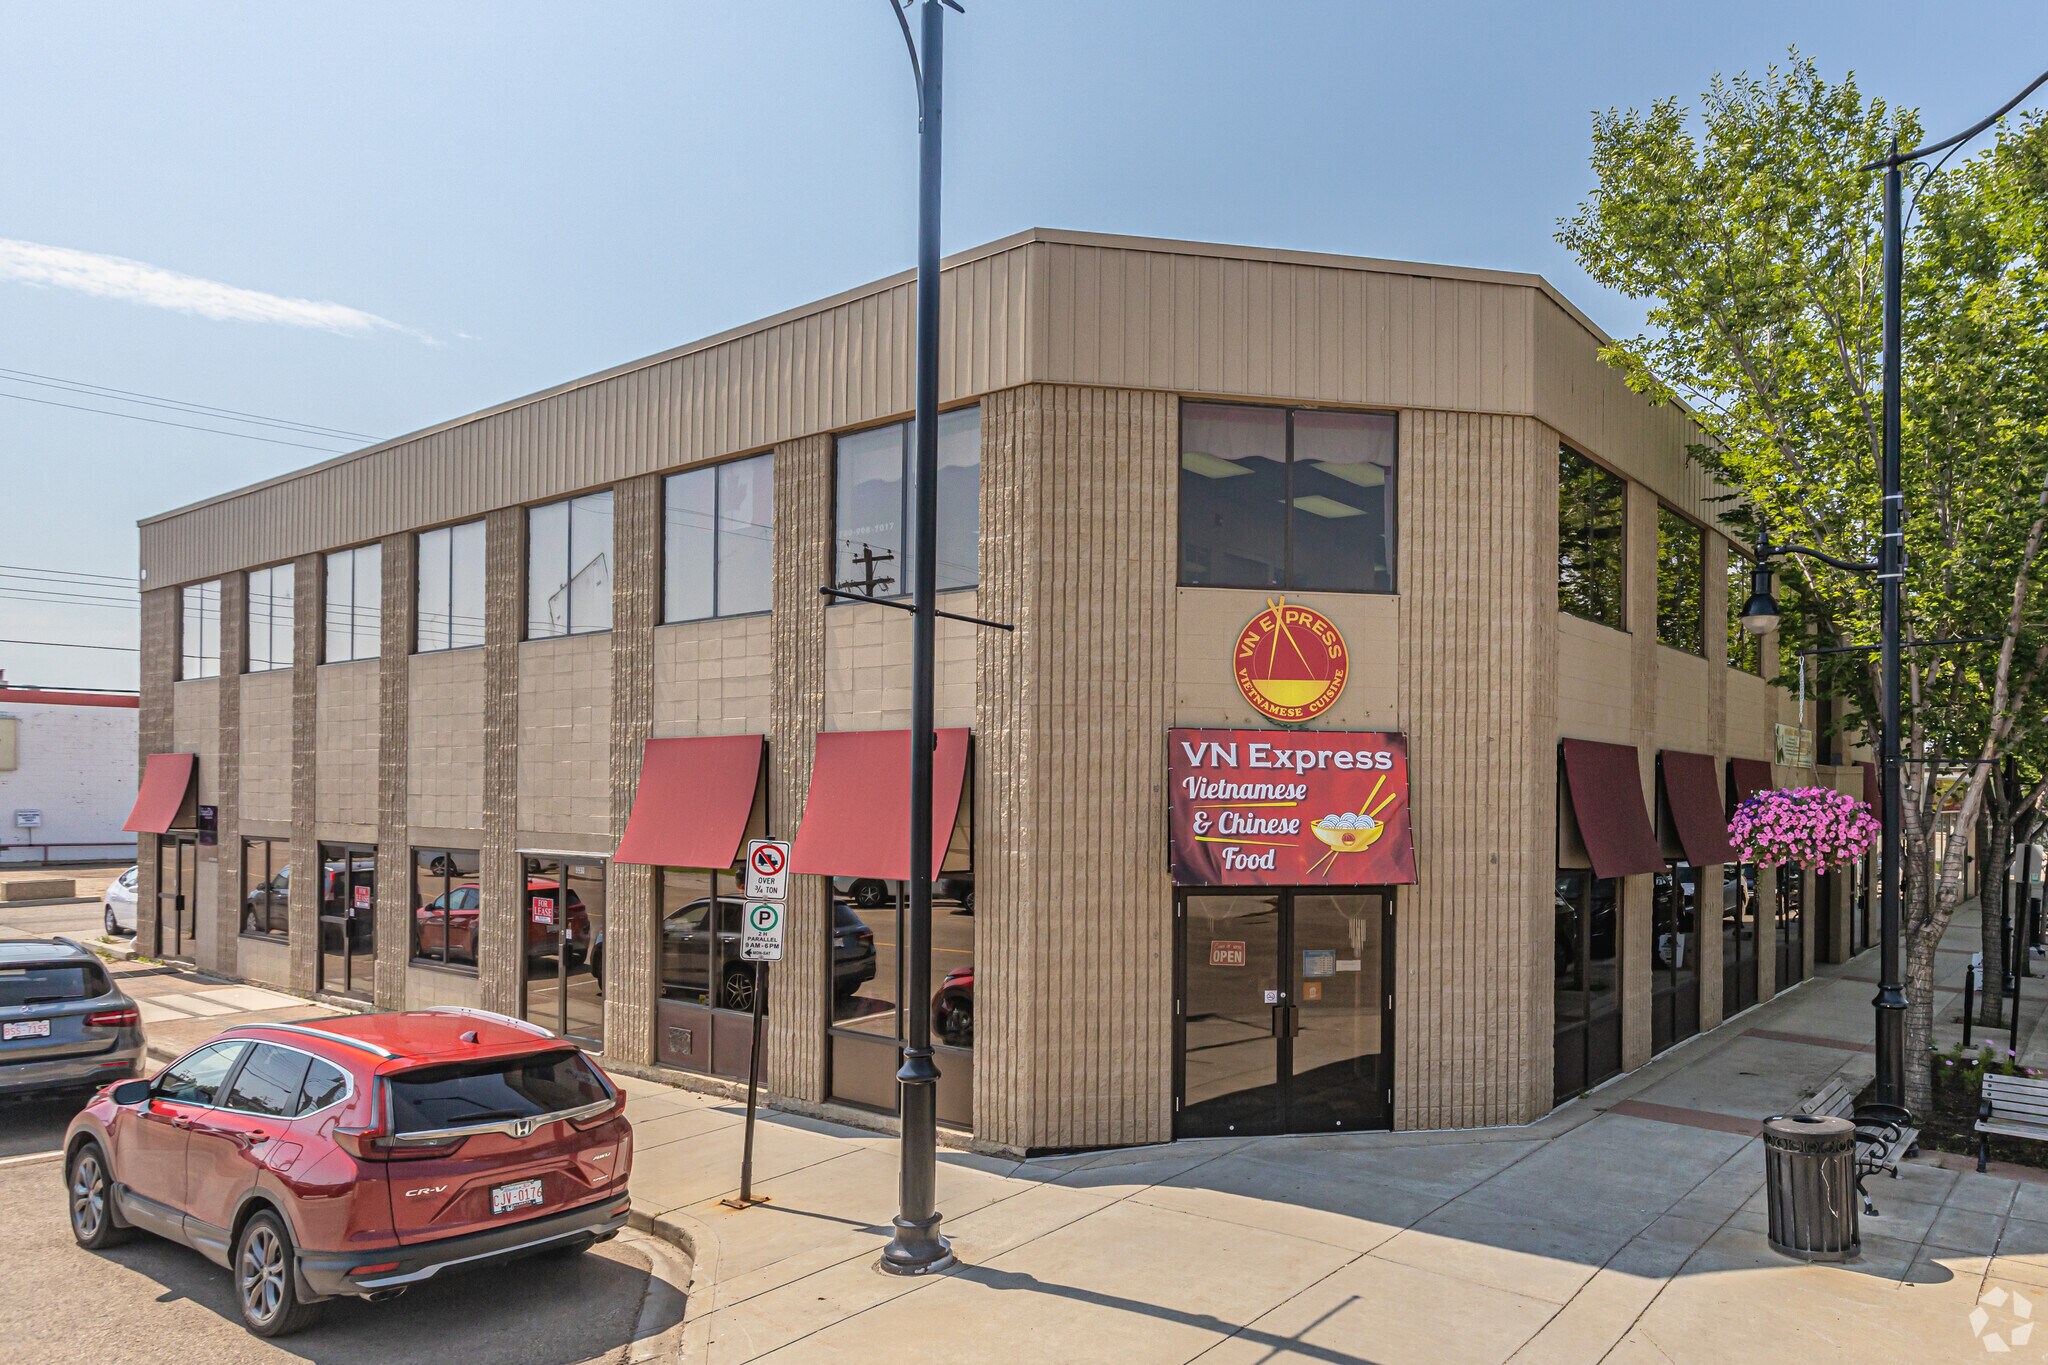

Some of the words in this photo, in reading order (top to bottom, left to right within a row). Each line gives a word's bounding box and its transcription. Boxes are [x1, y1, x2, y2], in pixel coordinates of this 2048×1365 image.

[1239, 631, 1260, 658] VN
[1239, 668, 1303, 716] VIETNAMESE
[1309, 669, 1344, 712] CUISINE
[1182, 742, 1237, 767] VN
[1249, 743, 1393, 774] Express
[1183, 776, 1307, 800] Vietnamese
[1193, 811, 1212, 834] &
[1218, 811, 1299, 836] Chinese
[1222, 847, 1276, 870] Food
[758, 877, 775, 885] OVER
[535, 906, 552, 916] LEASE
[538, 899, 548, 908] FOR
[759, 911, 771, 925] P
[1213, 950, 1242, 963] OPEN
[405, 1184, 448, 1197] CR-V
[493, 1186, 542, 1207] CJV-0176
